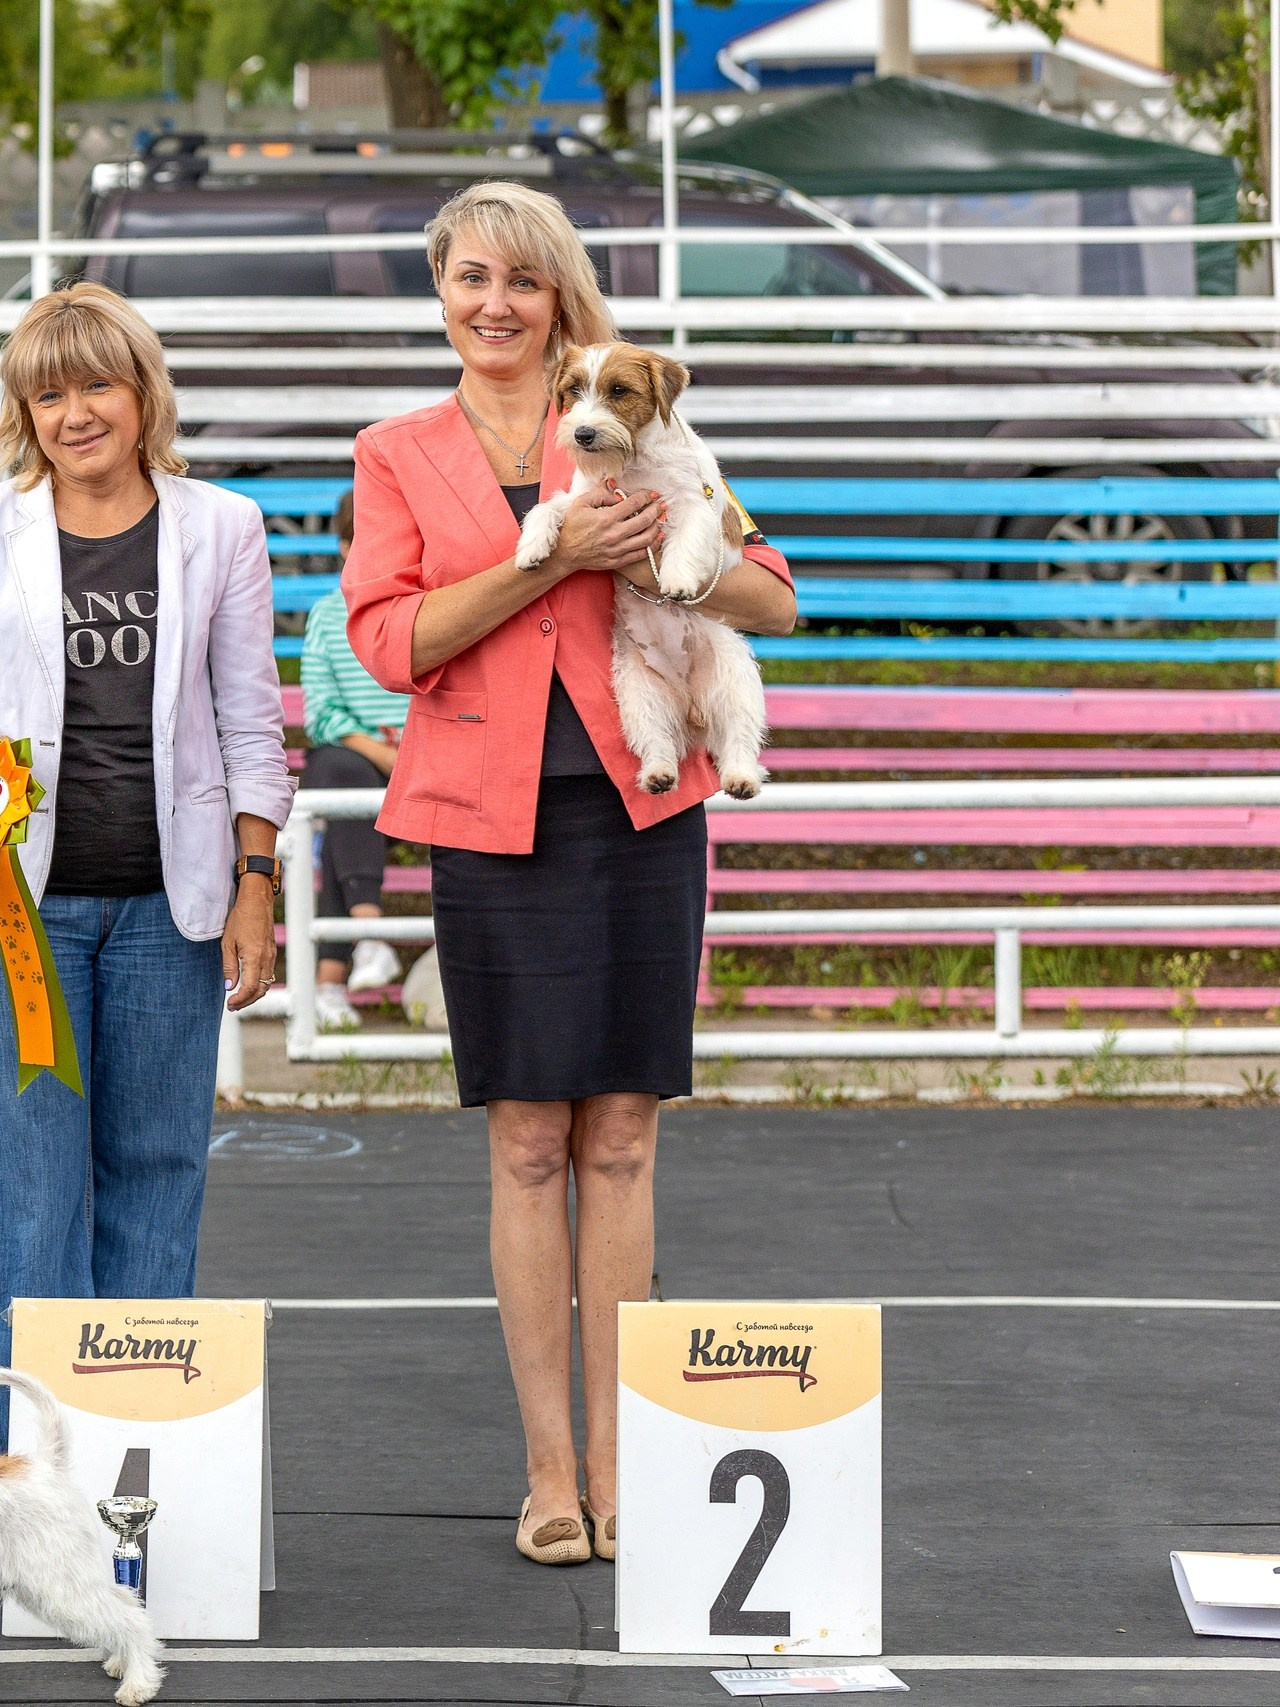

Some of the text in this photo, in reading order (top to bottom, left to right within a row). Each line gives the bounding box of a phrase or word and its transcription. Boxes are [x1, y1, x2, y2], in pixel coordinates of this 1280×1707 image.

[62, 590, 158, 624] ANC
[66, 625, 156, 668] OO
[132, 1316, 165, 1327] заботой
[166, 1317, 199, 1328] навсегда
[744, 1321, 778, 1333] заботой
[779, 1322, 814, 1334] навсегда
[78, 1323, 197, 1384] Karmy
[688, 1328, 813, 1393] Karmy
[709, 1448, 791, 1636] 2
